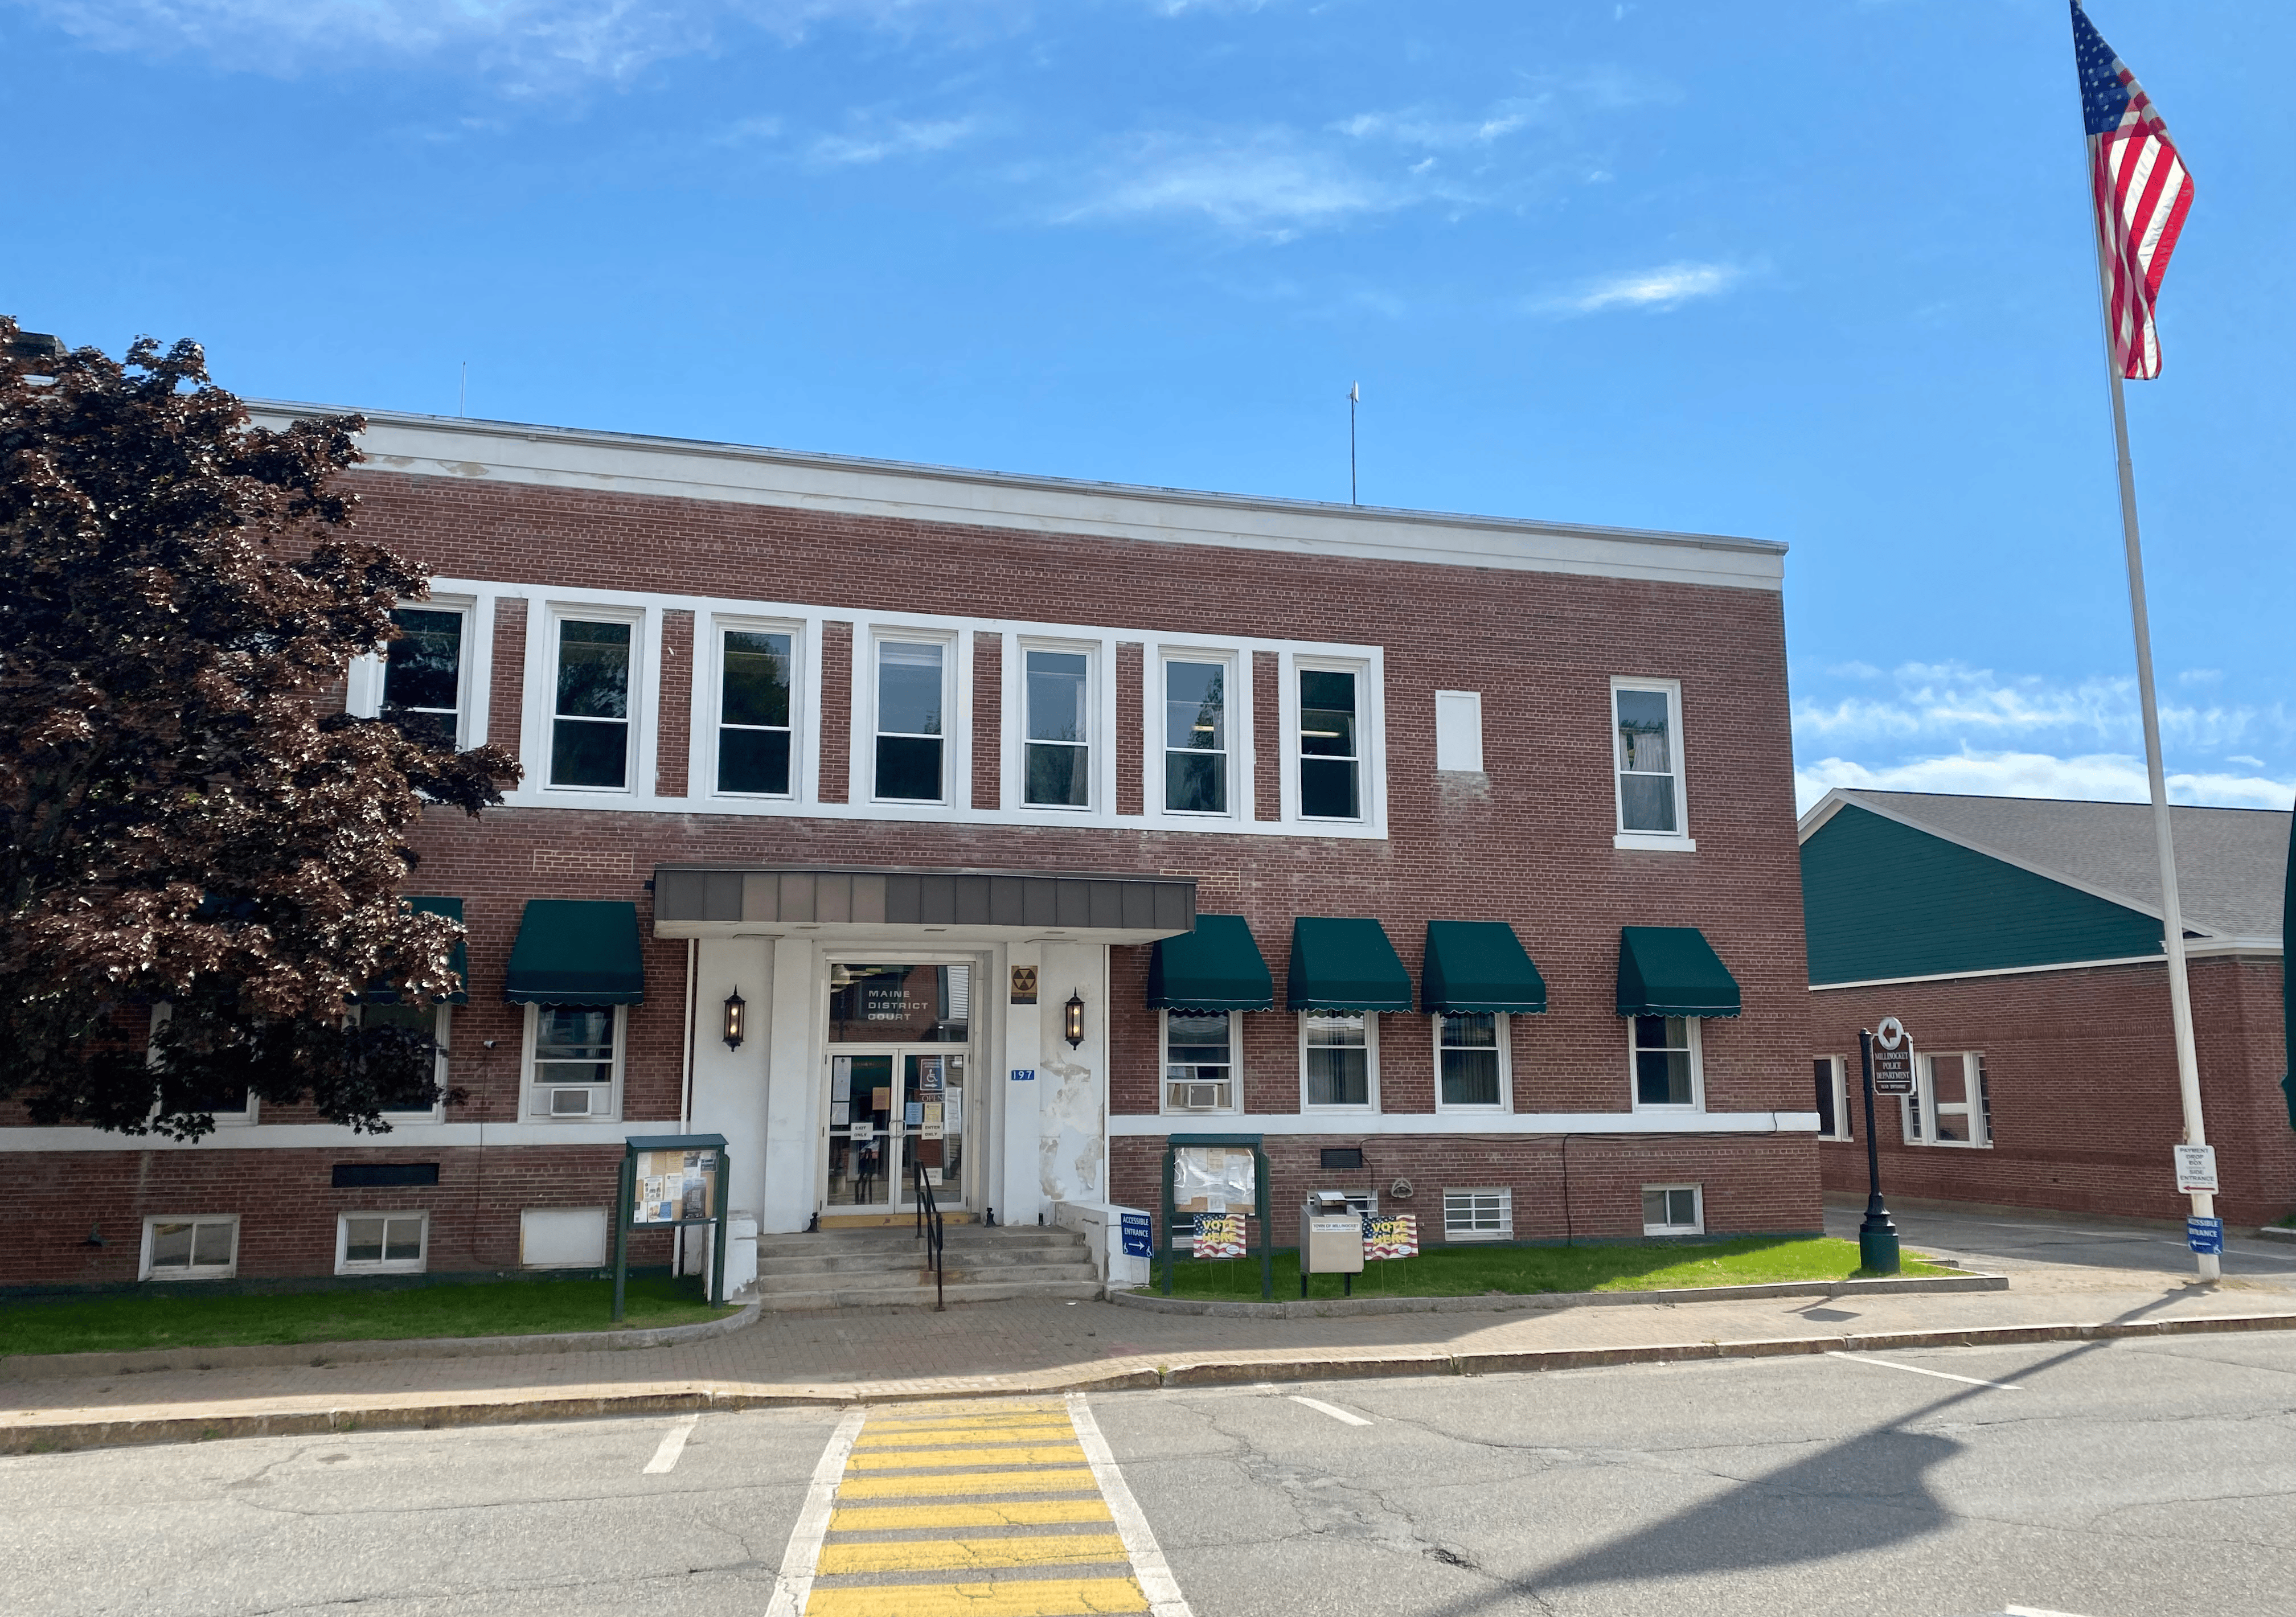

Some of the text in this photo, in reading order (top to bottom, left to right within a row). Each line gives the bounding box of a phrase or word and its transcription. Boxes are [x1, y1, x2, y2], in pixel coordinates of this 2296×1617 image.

[1875, 1052, 1909, 1060] MILLINOCKET
[1012, 1070, 1032, 1080] 197
[1876, 1071, 1910, 1080] DEPARTMENT
[1123, 1216, 1149, 1226] ACCESSIBLE
[1202, 1220, 1236, 1230] VOTE
[1124, 1227, 1149, 1237] ENTRANCE
[1371, 1221, 1407, 1233] VOTE
[1202, 1232, 1237, 1242] HERE
[1372, 1233, 1409, 1244] HERE
